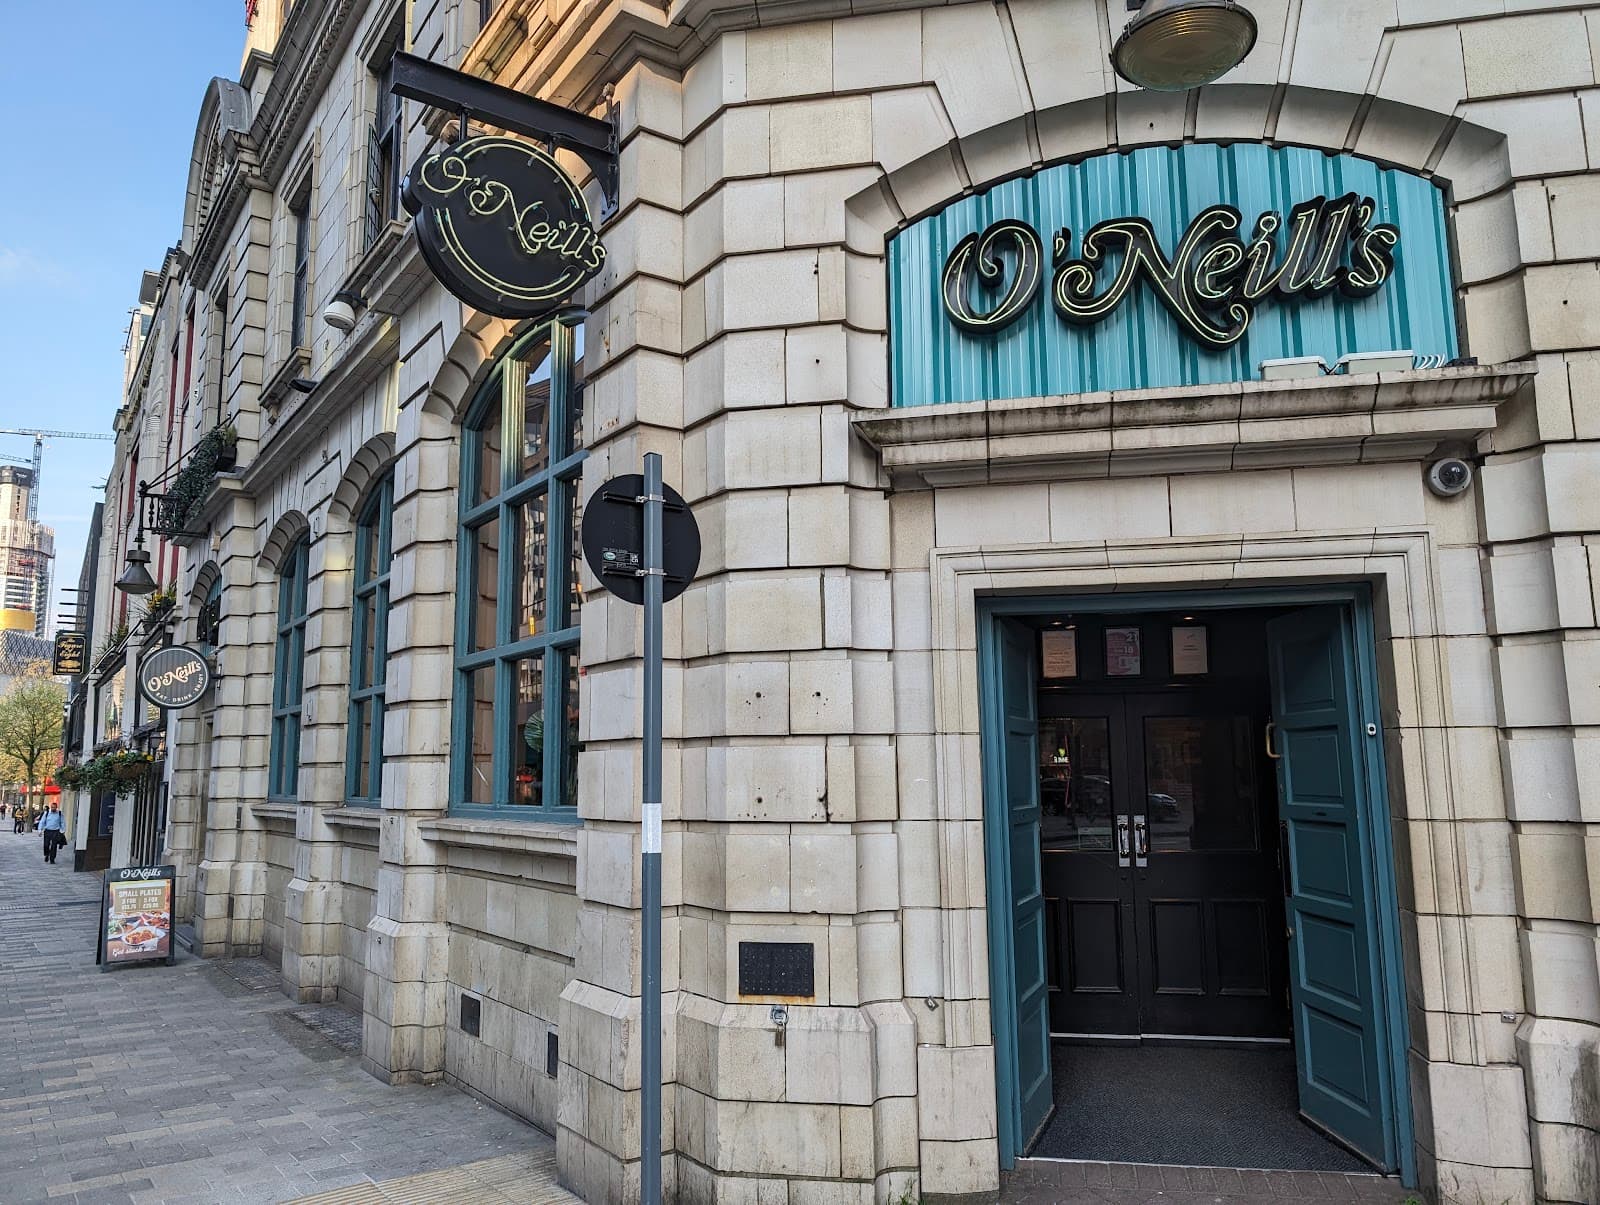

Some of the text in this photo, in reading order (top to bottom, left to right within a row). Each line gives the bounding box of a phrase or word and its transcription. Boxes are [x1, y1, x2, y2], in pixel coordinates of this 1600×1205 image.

[421, 154, 606, 268] O'Neill's
[943, 192, 1401, 350] O'Neill's
[147, 660, 202, 692] O'Neill's
[118, 890, 139, 898] SMALL
